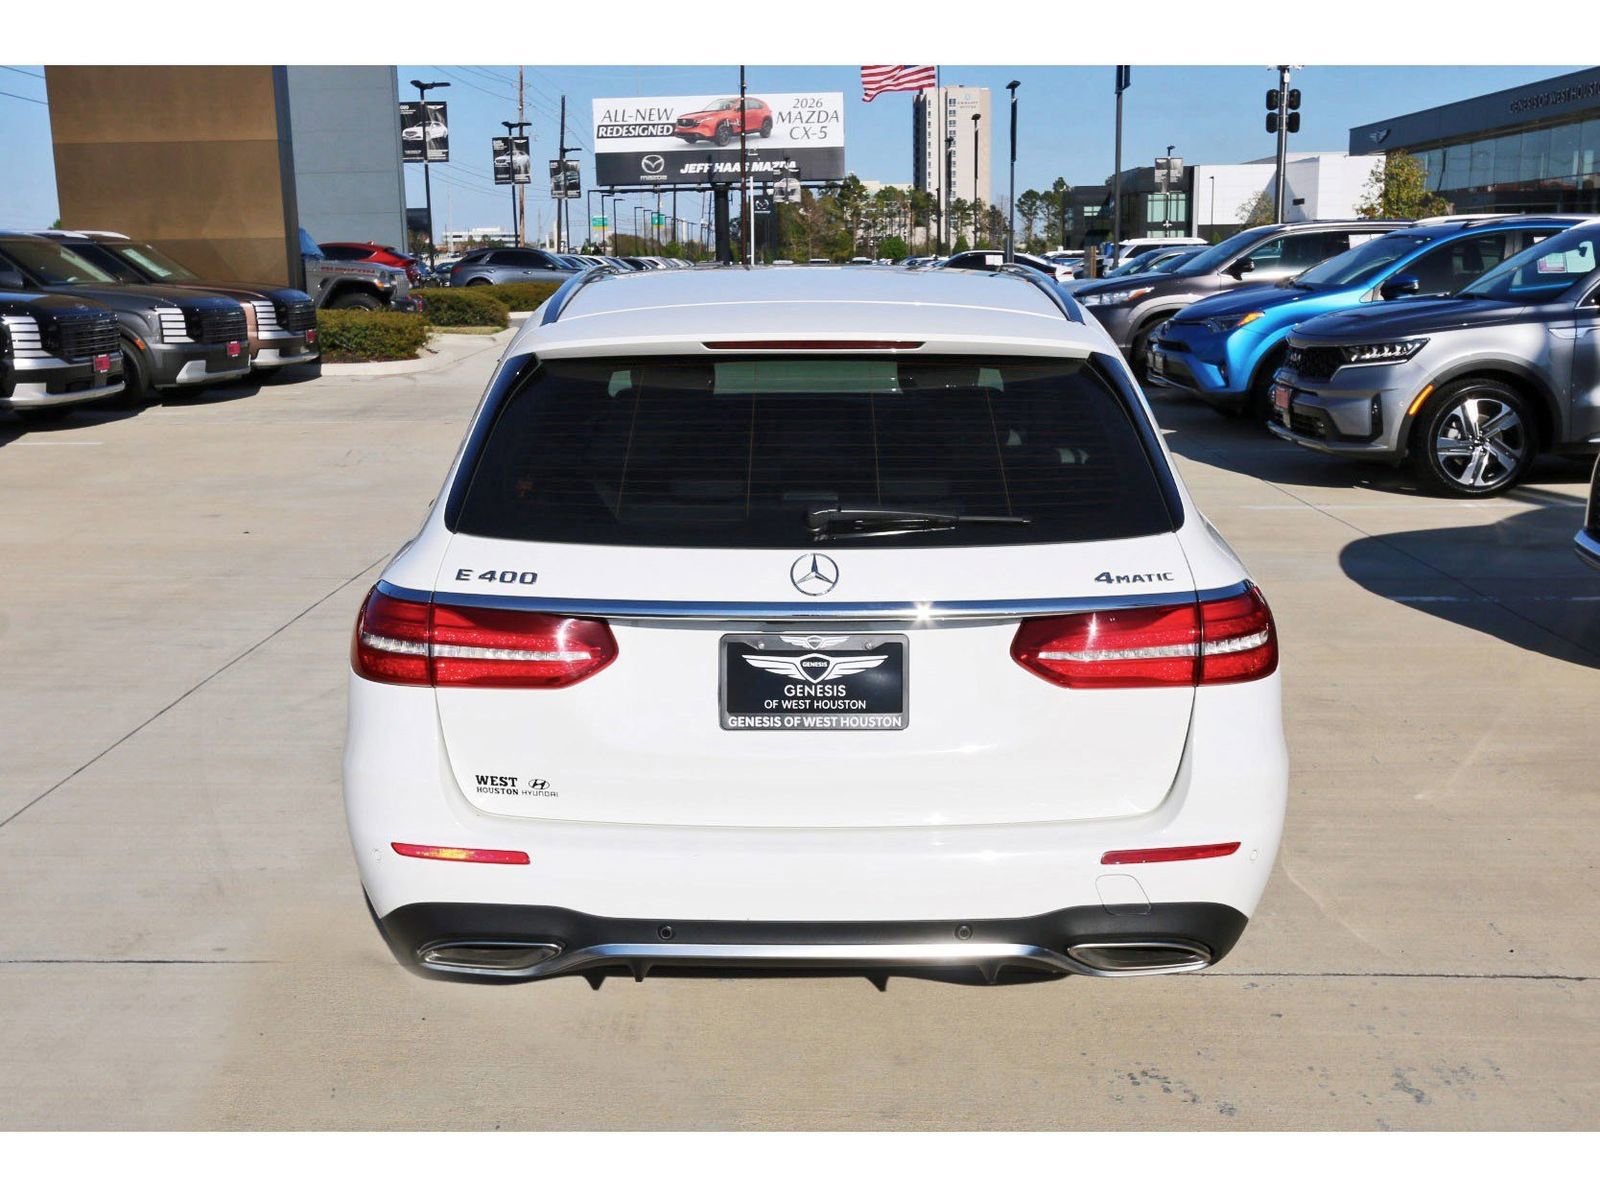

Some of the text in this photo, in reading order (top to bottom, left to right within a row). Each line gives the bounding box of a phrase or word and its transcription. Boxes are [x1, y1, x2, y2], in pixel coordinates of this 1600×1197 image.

[793, 97, 823, 109] 2026
[600, 107, 674, 123] ALL-NEW
[775, 109, 840, 124] MAZDA
[598, 124, 674, 137] REDESIGNED
[789, 125, 828, 140] CX-5
[680, 163, 713, 174] JEFF
[455, 568, 538, 585] E 400
[1094, 571, 1175, 584] 4MATIC
[802, 660, 828, 668] GENESIS
[784, 684, 846, 697] GENESIS
[764, 699, 866, 710] OF WEST HOUSTON
[728, 715, 902, 728] GENESIS OF WEST HOUSTON
[475, 774, 518, 787] WEST
[476, 786, 559, 797] HOUSTON HYUNDAI
